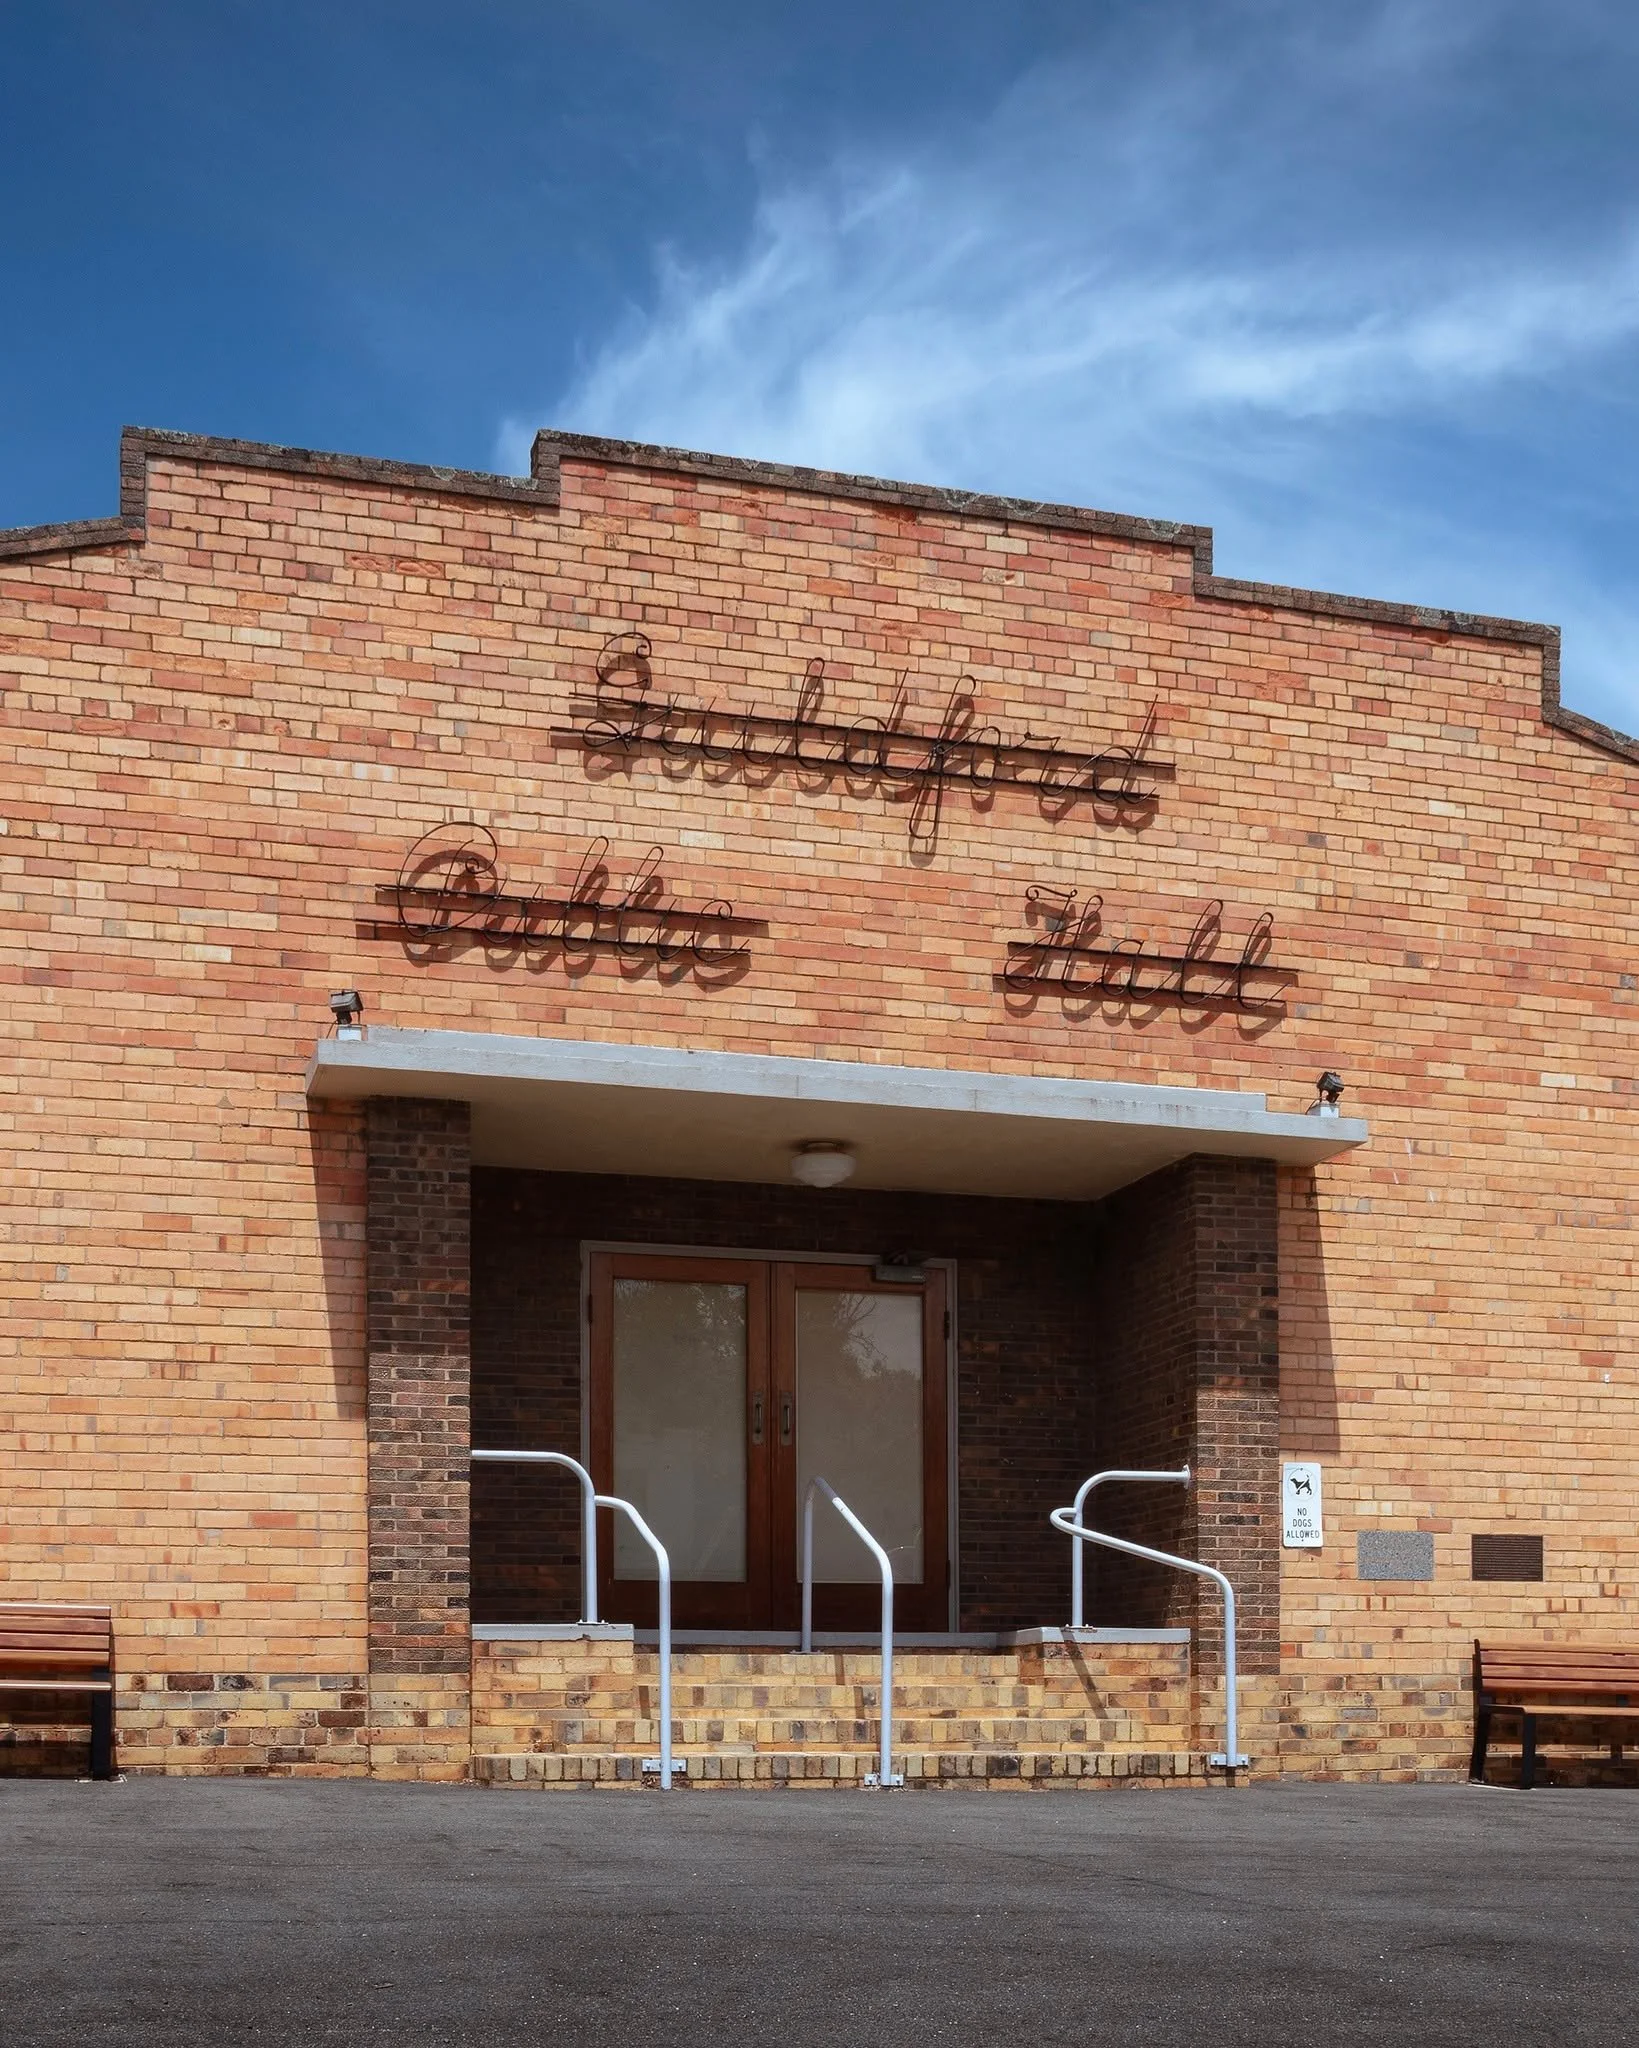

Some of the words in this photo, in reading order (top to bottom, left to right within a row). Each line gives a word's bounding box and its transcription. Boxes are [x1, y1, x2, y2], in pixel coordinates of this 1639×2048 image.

[583, 631, 1156, 839] Guildford
[399, 821, 750, 963] Public
[1004, 884, 1289, 1010] Hall
[1297, 1507, 1308, 1516] NO
[1292, 1518, 1313, 1528] DOGS
[1286, 1530, 1320, 1539] ALLOWED
